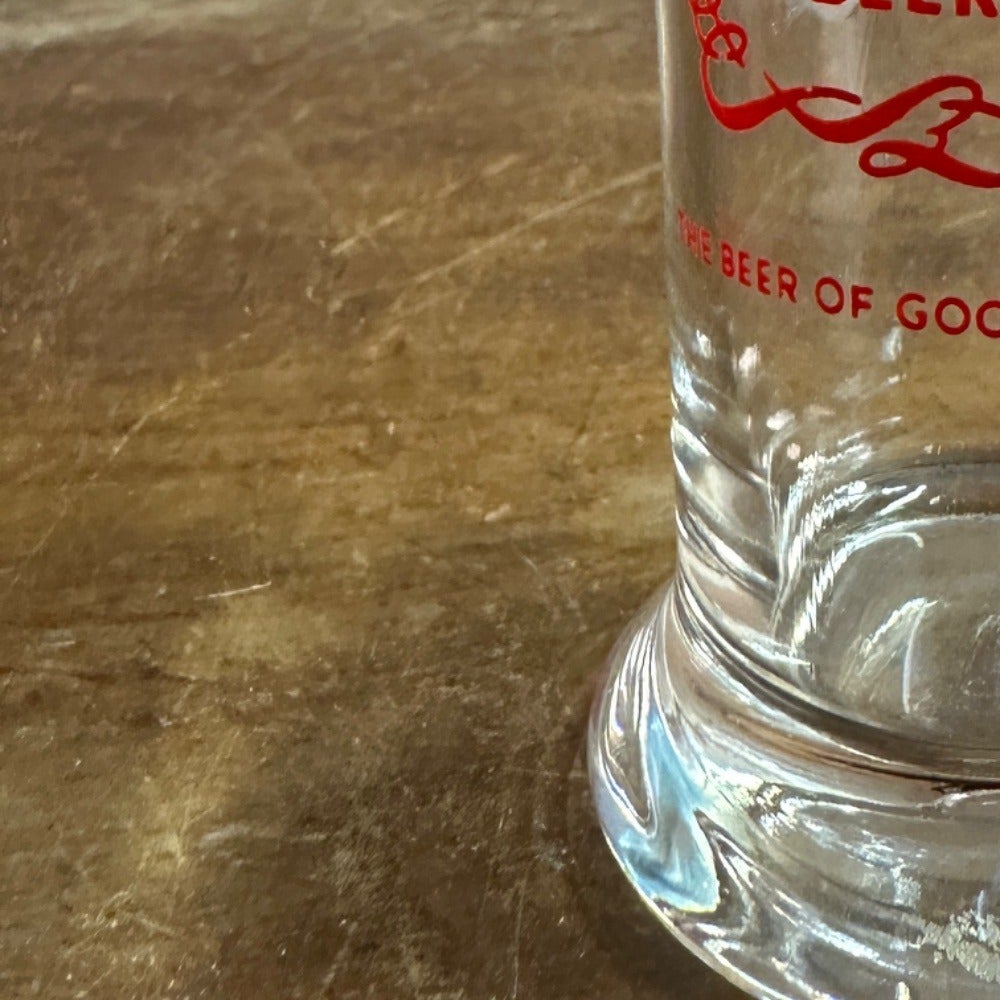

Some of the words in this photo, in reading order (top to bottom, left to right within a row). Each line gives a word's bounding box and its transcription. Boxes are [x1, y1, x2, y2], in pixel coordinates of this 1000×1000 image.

[678, 208, 712, 266] THE
[720, 239, 799, 303] BEER
[815, 276, 874, 318] OF
